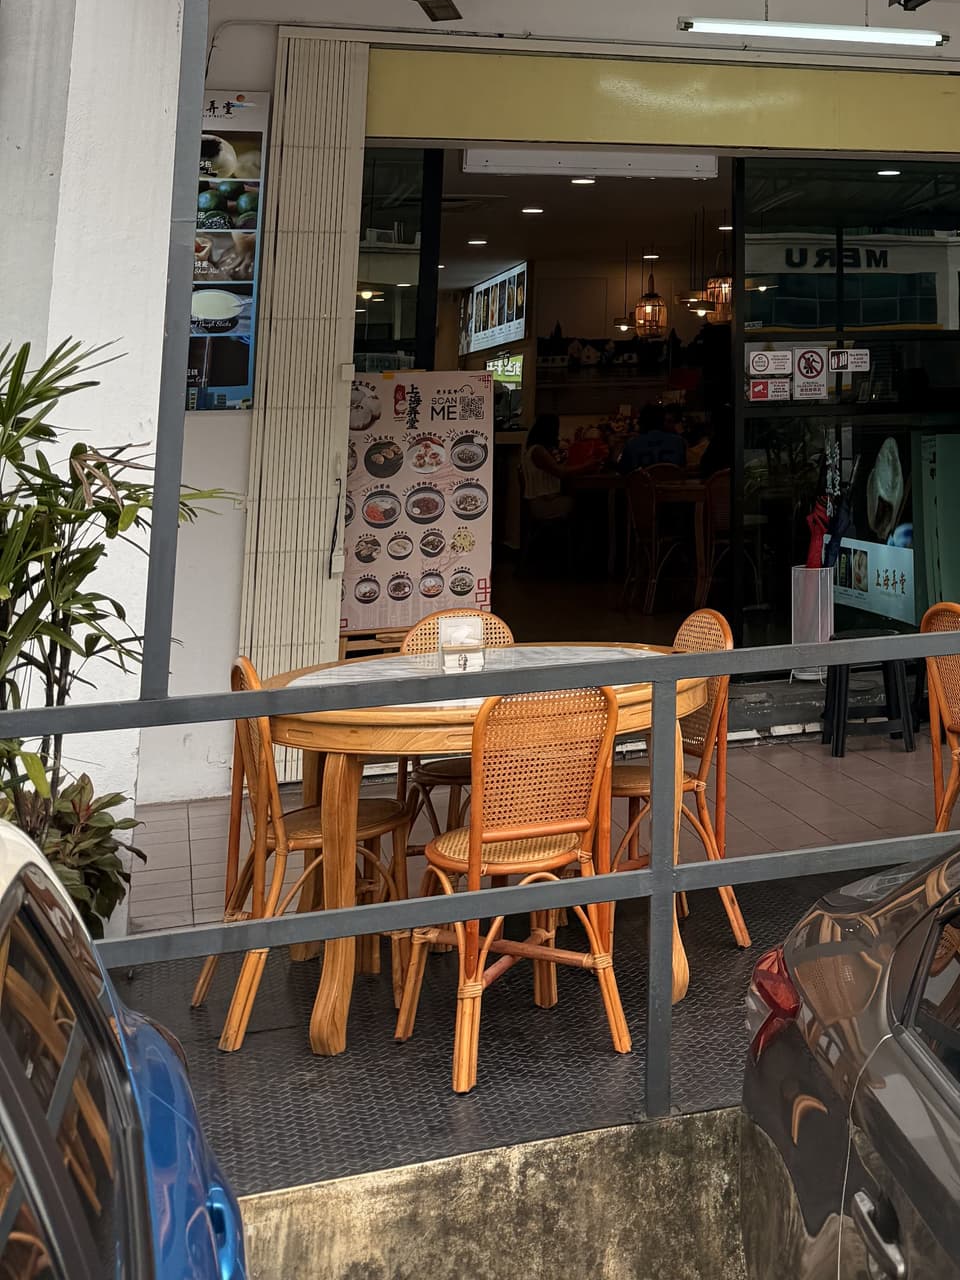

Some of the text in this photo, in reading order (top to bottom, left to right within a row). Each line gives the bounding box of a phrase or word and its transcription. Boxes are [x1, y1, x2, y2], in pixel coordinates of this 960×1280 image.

[406, 383, 422, 430] 上海弄堂
[431, 397, 458, 405] SCAN
[430, 405, 457, 421] ME
